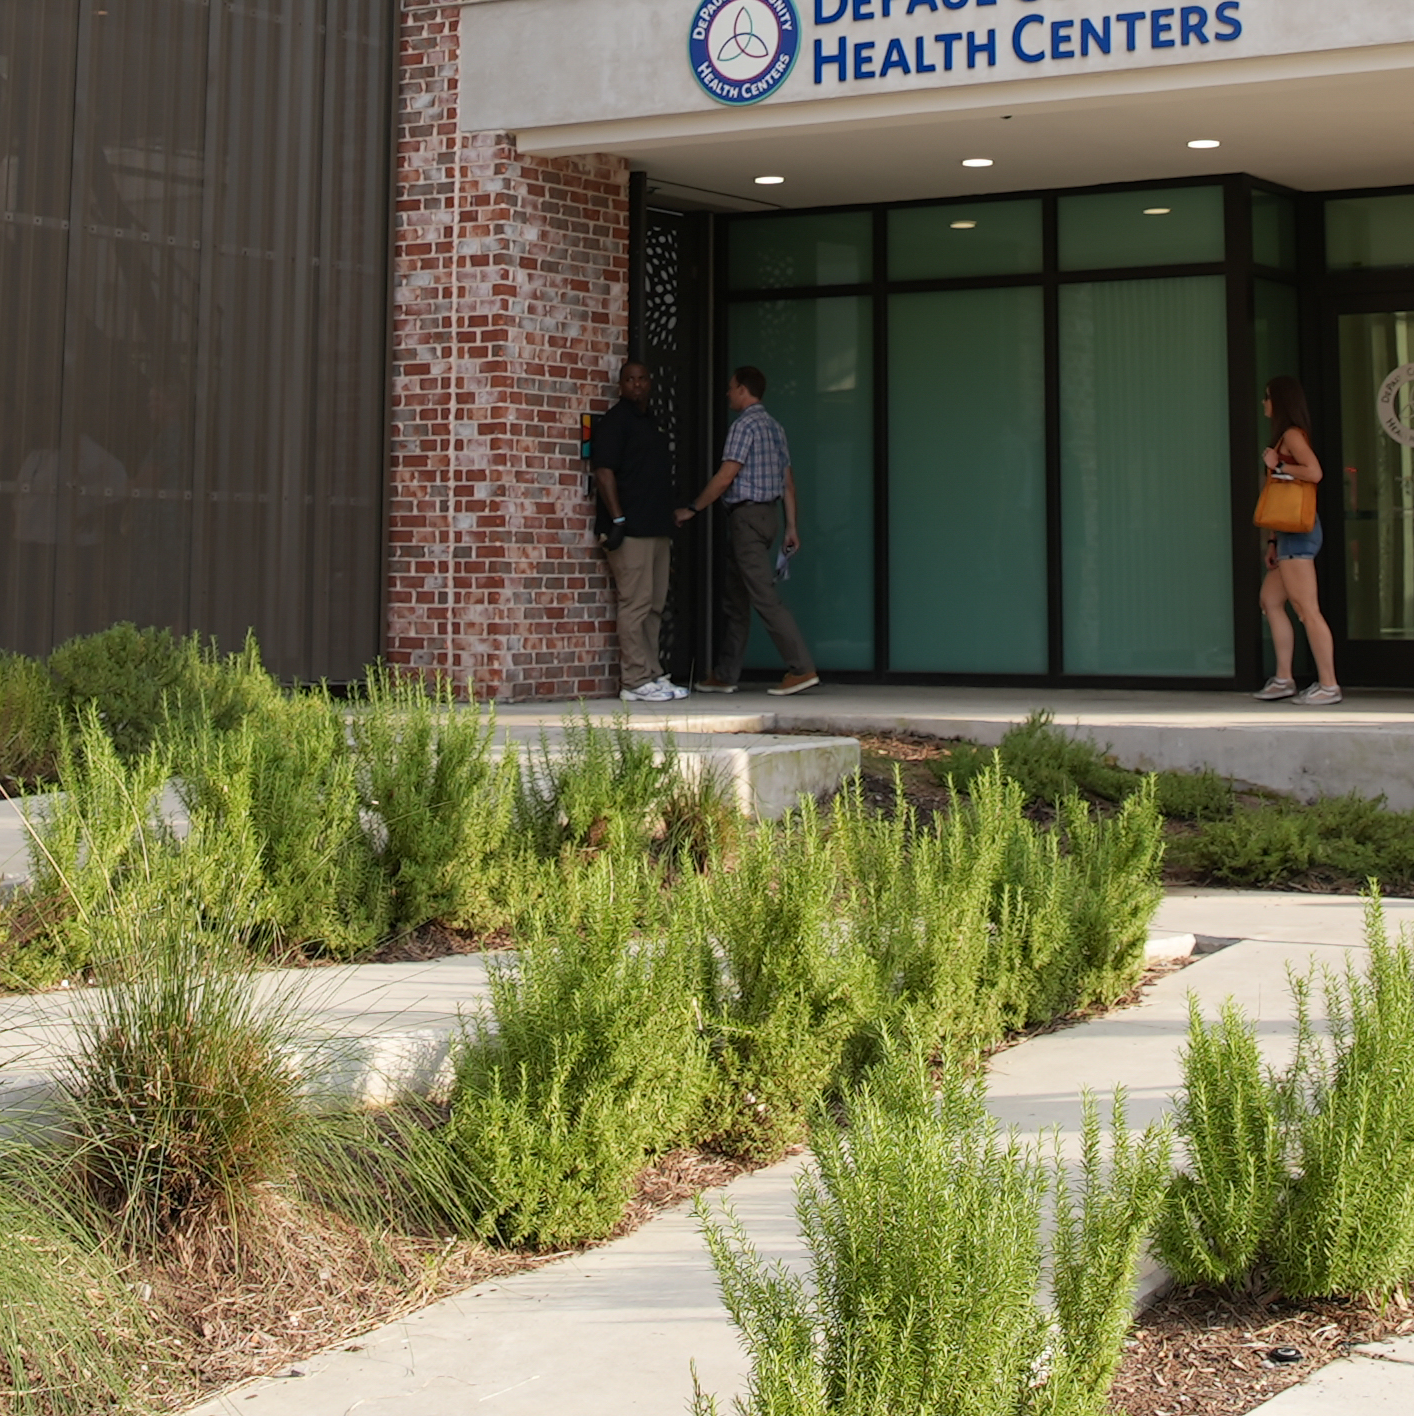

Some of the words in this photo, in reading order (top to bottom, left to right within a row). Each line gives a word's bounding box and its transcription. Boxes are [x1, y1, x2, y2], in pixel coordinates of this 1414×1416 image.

[814, 28, 997, 84] HEALTH
[1012, 1, 1243, 63] CENTERS
[697, 61, 739, 98] HEALTH
[741, 53, 790, 98] CENTERS
